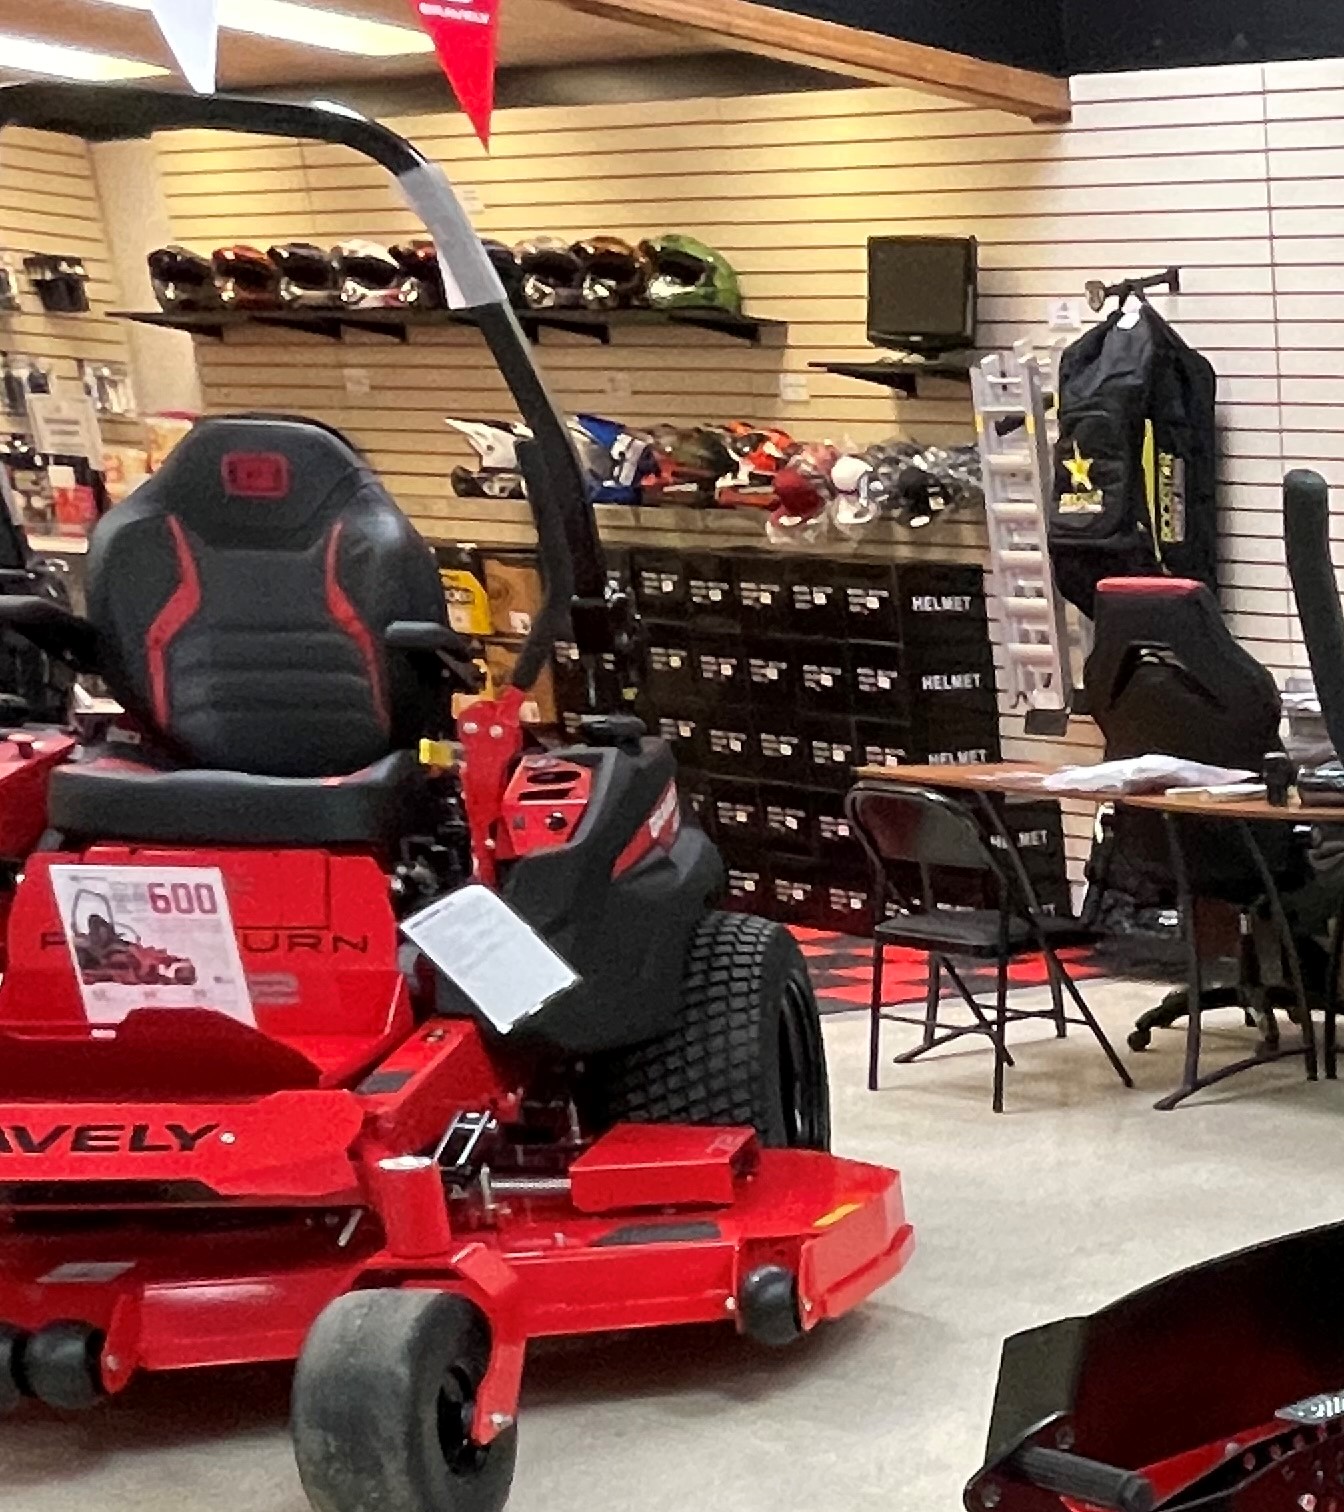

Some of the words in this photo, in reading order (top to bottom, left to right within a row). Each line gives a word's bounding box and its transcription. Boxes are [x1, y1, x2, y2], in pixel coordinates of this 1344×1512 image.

[912, 595, 971, 612] HELMET
[922, 672, 981, 690] HELMET
[147, 882, 218, 914] 600
[0, 1123, 220, 1154] VELY
